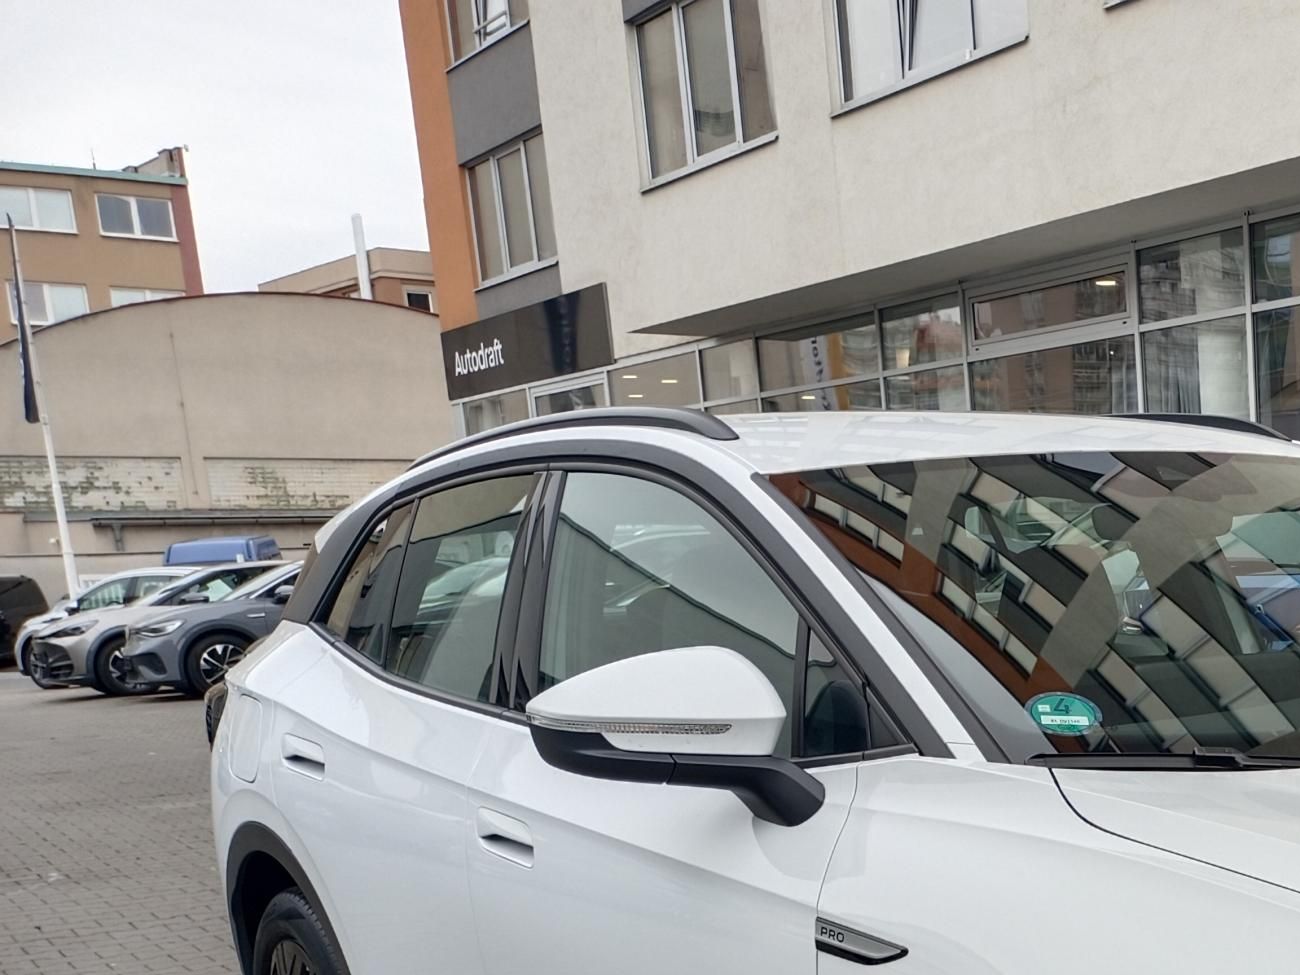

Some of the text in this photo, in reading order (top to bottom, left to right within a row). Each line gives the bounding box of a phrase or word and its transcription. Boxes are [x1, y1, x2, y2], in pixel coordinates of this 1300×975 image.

[455, 338, 504, 376] Autodraft
[1053, 698, 1071, 714] 4
[820, 926, 845, 943] PRO
